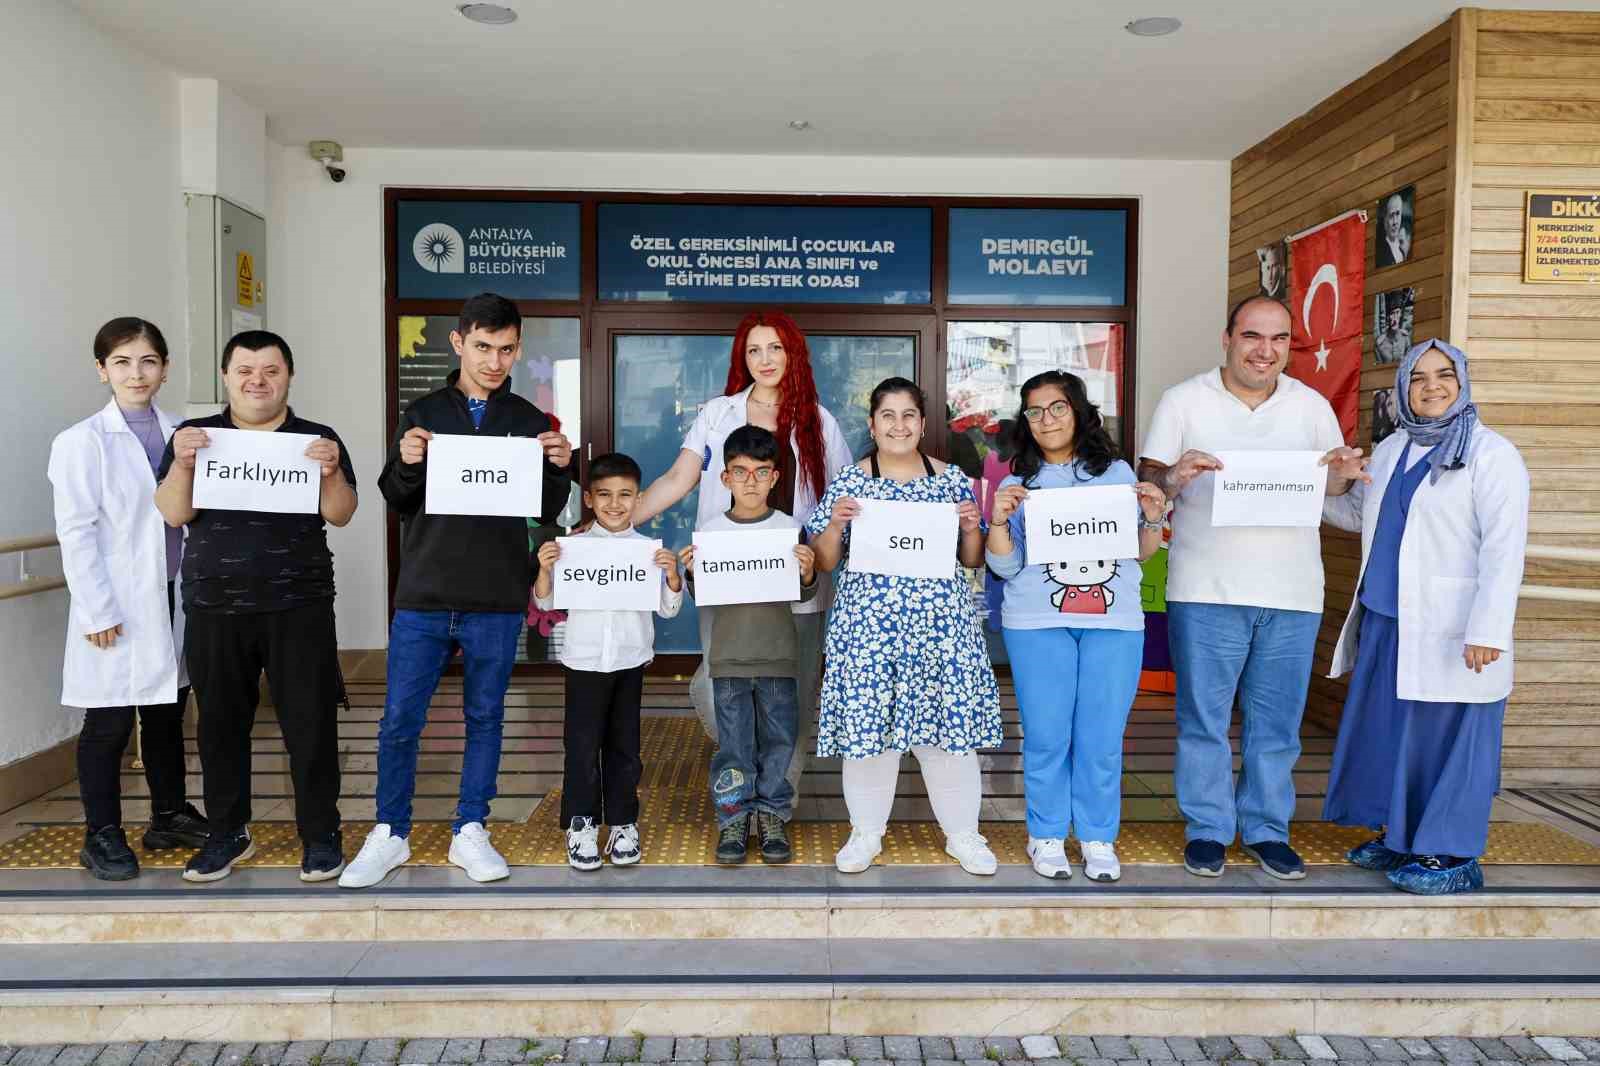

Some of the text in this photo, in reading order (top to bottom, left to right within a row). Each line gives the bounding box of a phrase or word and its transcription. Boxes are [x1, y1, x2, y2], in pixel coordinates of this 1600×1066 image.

[469, 228, 533, 241] ANTALYA
[1537, 223, 1593, 232] MERKEZİMİZ
[630, 235, 895, 254] ÖZEL GEREKSİNİMLİ ÇOCUKLAR
[1537, 235, 1558, 244] 7/24
[469, 242, 566, 259] BÜYÜKŞEHİR
[469, 260, 545, 275] BELEDİYESİ
[647, 253, 879, 270] OKUL ÖNCESİ ANA SINIFI ve
[665, 270, 860, 288] EĞİTİME DESTEK ODASI
[206, 460, 309, 486] Farklıyım
[461, 468, 509, 485] ama
[1223, 479, 1315, 493] kahramanımsın
[1050, 516, 1118, 538] benim
[888, 534, 925, 551] sen
[701, 556, 785, 574] tamamım
[563, 564, 647, 586] sevginle
